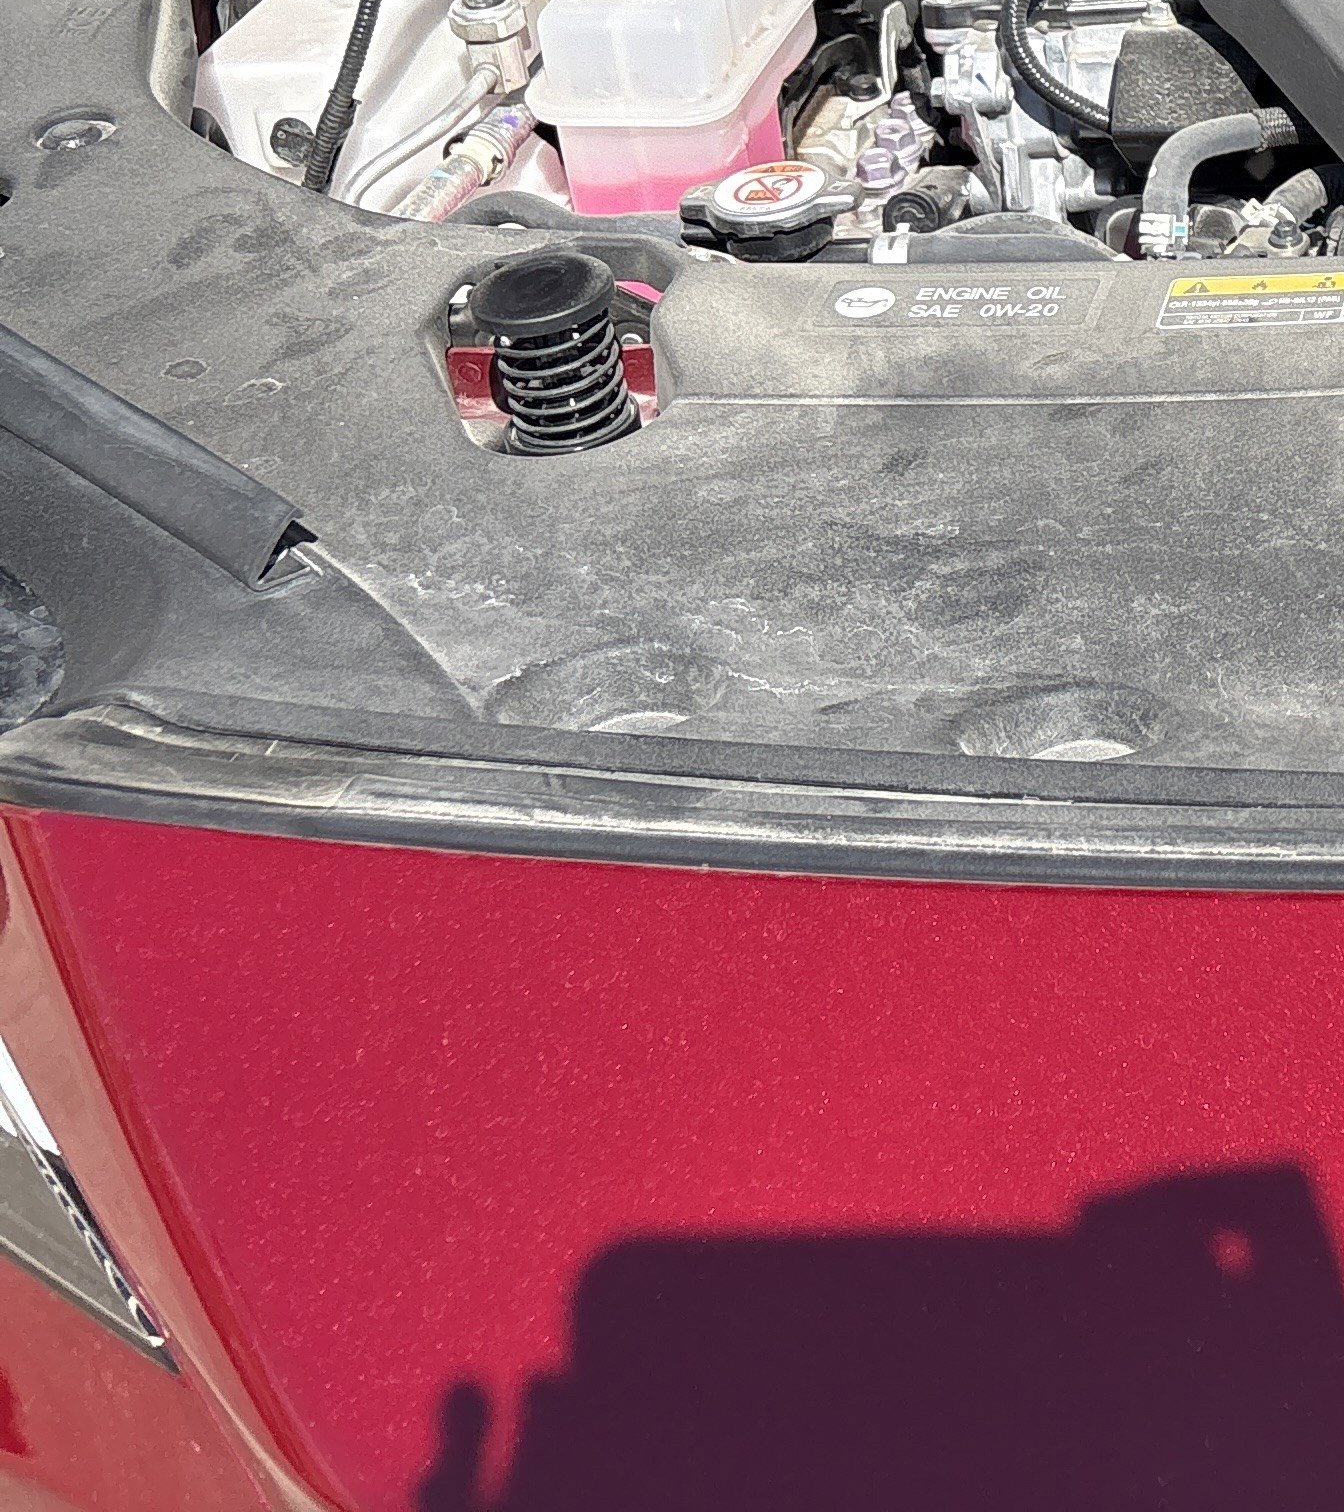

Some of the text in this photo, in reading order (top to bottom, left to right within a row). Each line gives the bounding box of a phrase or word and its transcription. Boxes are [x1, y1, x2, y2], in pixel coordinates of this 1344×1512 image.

[915, 286, 1067, 300] ENGINE OIL
[907, 303, 1060, 318] SAE 0W-20
